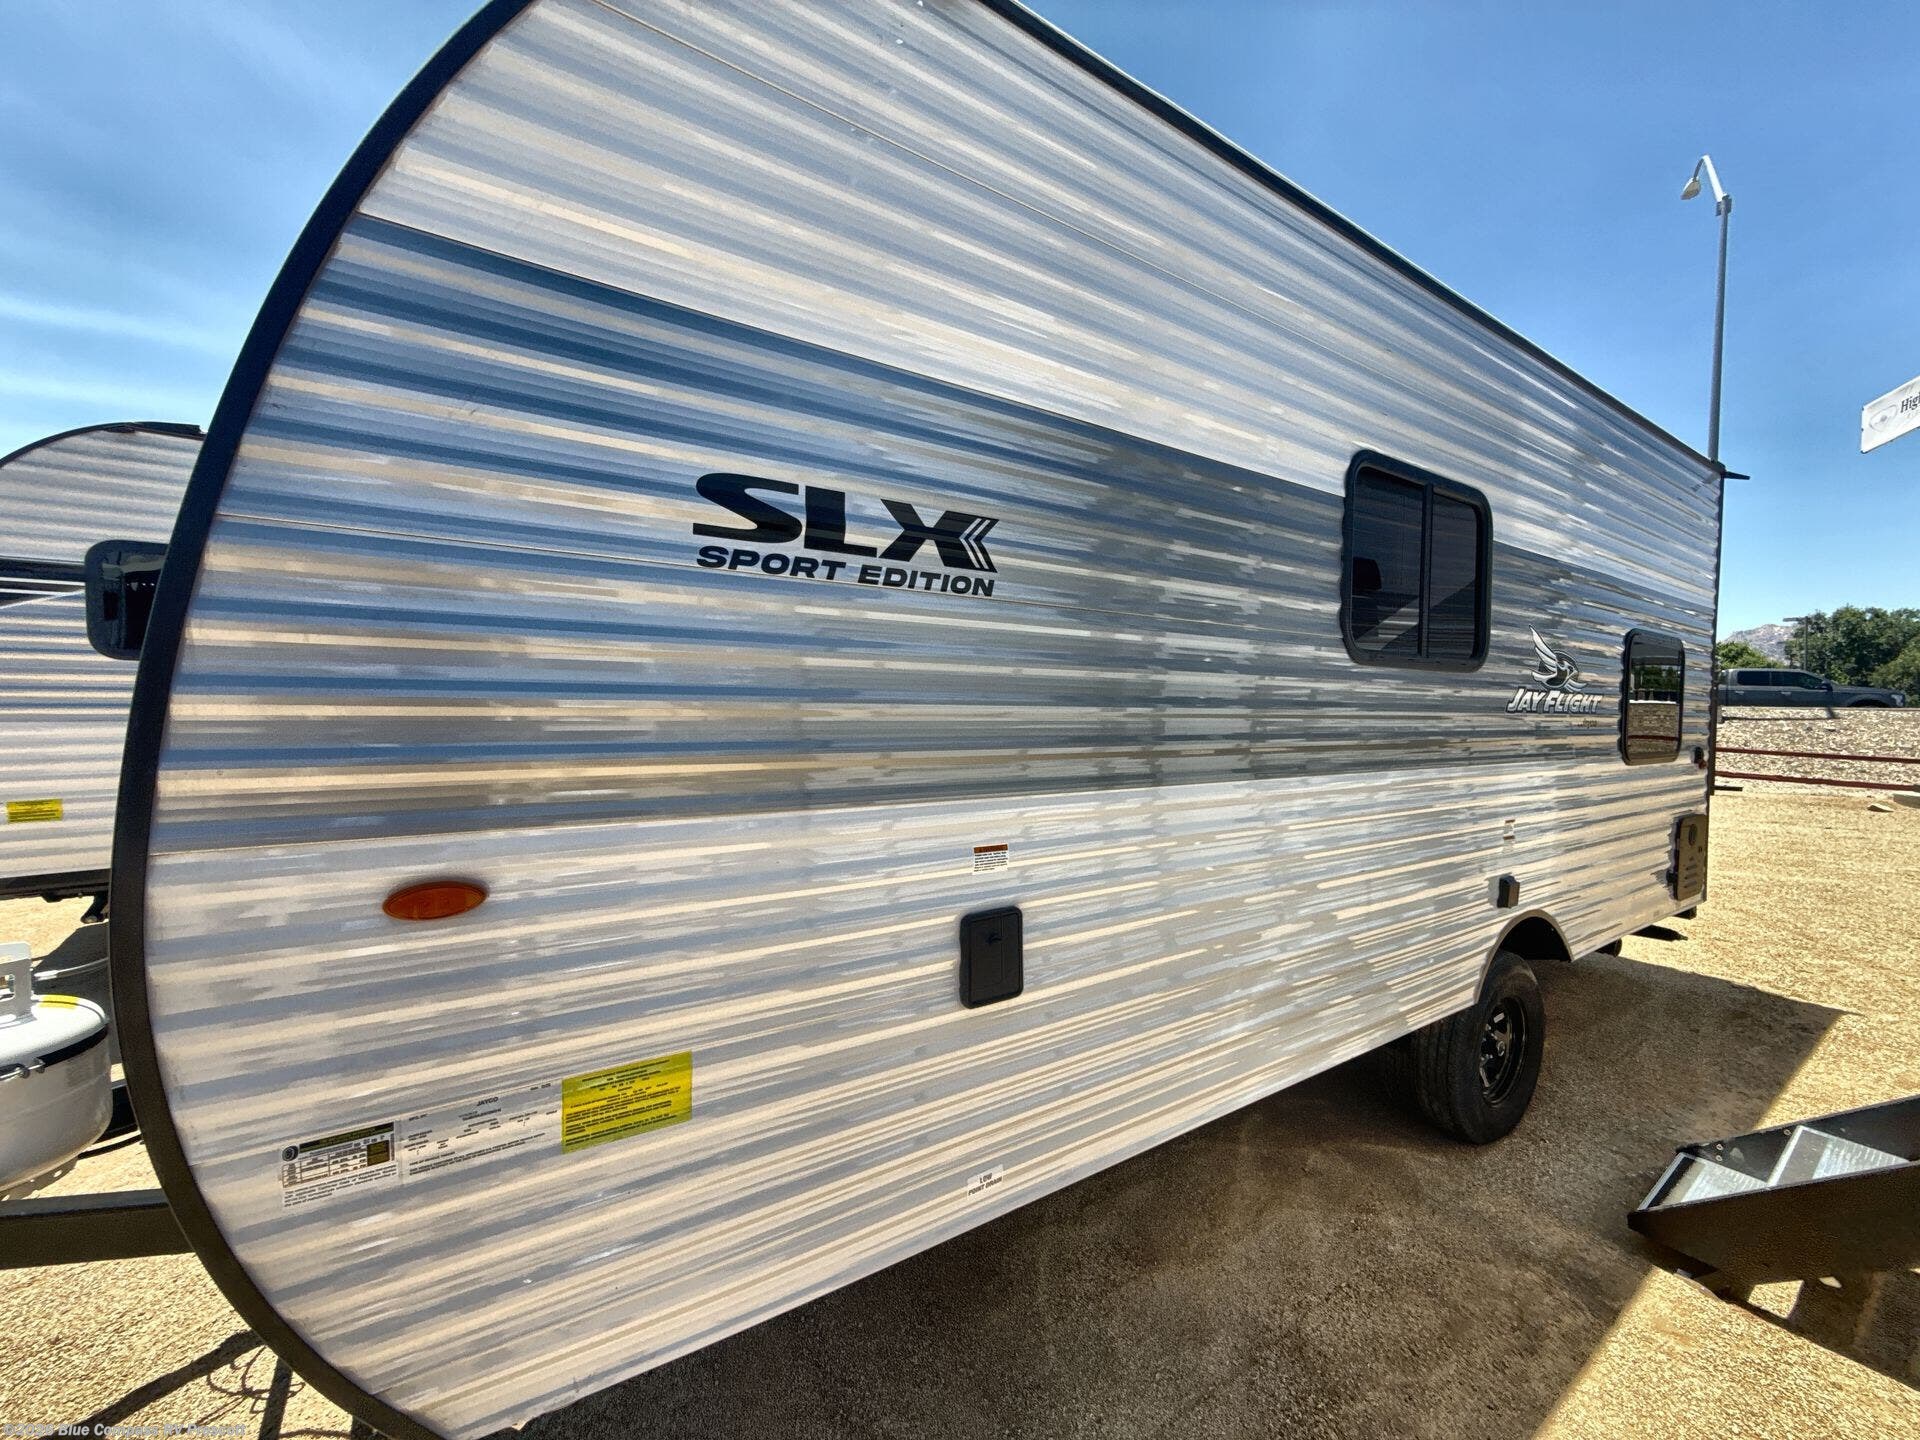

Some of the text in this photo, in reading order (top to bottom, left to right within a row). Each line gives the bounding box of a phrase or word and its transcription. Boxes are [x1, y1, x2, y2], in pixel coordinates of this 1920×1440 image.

[693, 472, 999, 573] SLX
[696, 546, 995, 597] SPORT EDITION
[476, 1096, 499, 1107] JAYCO
